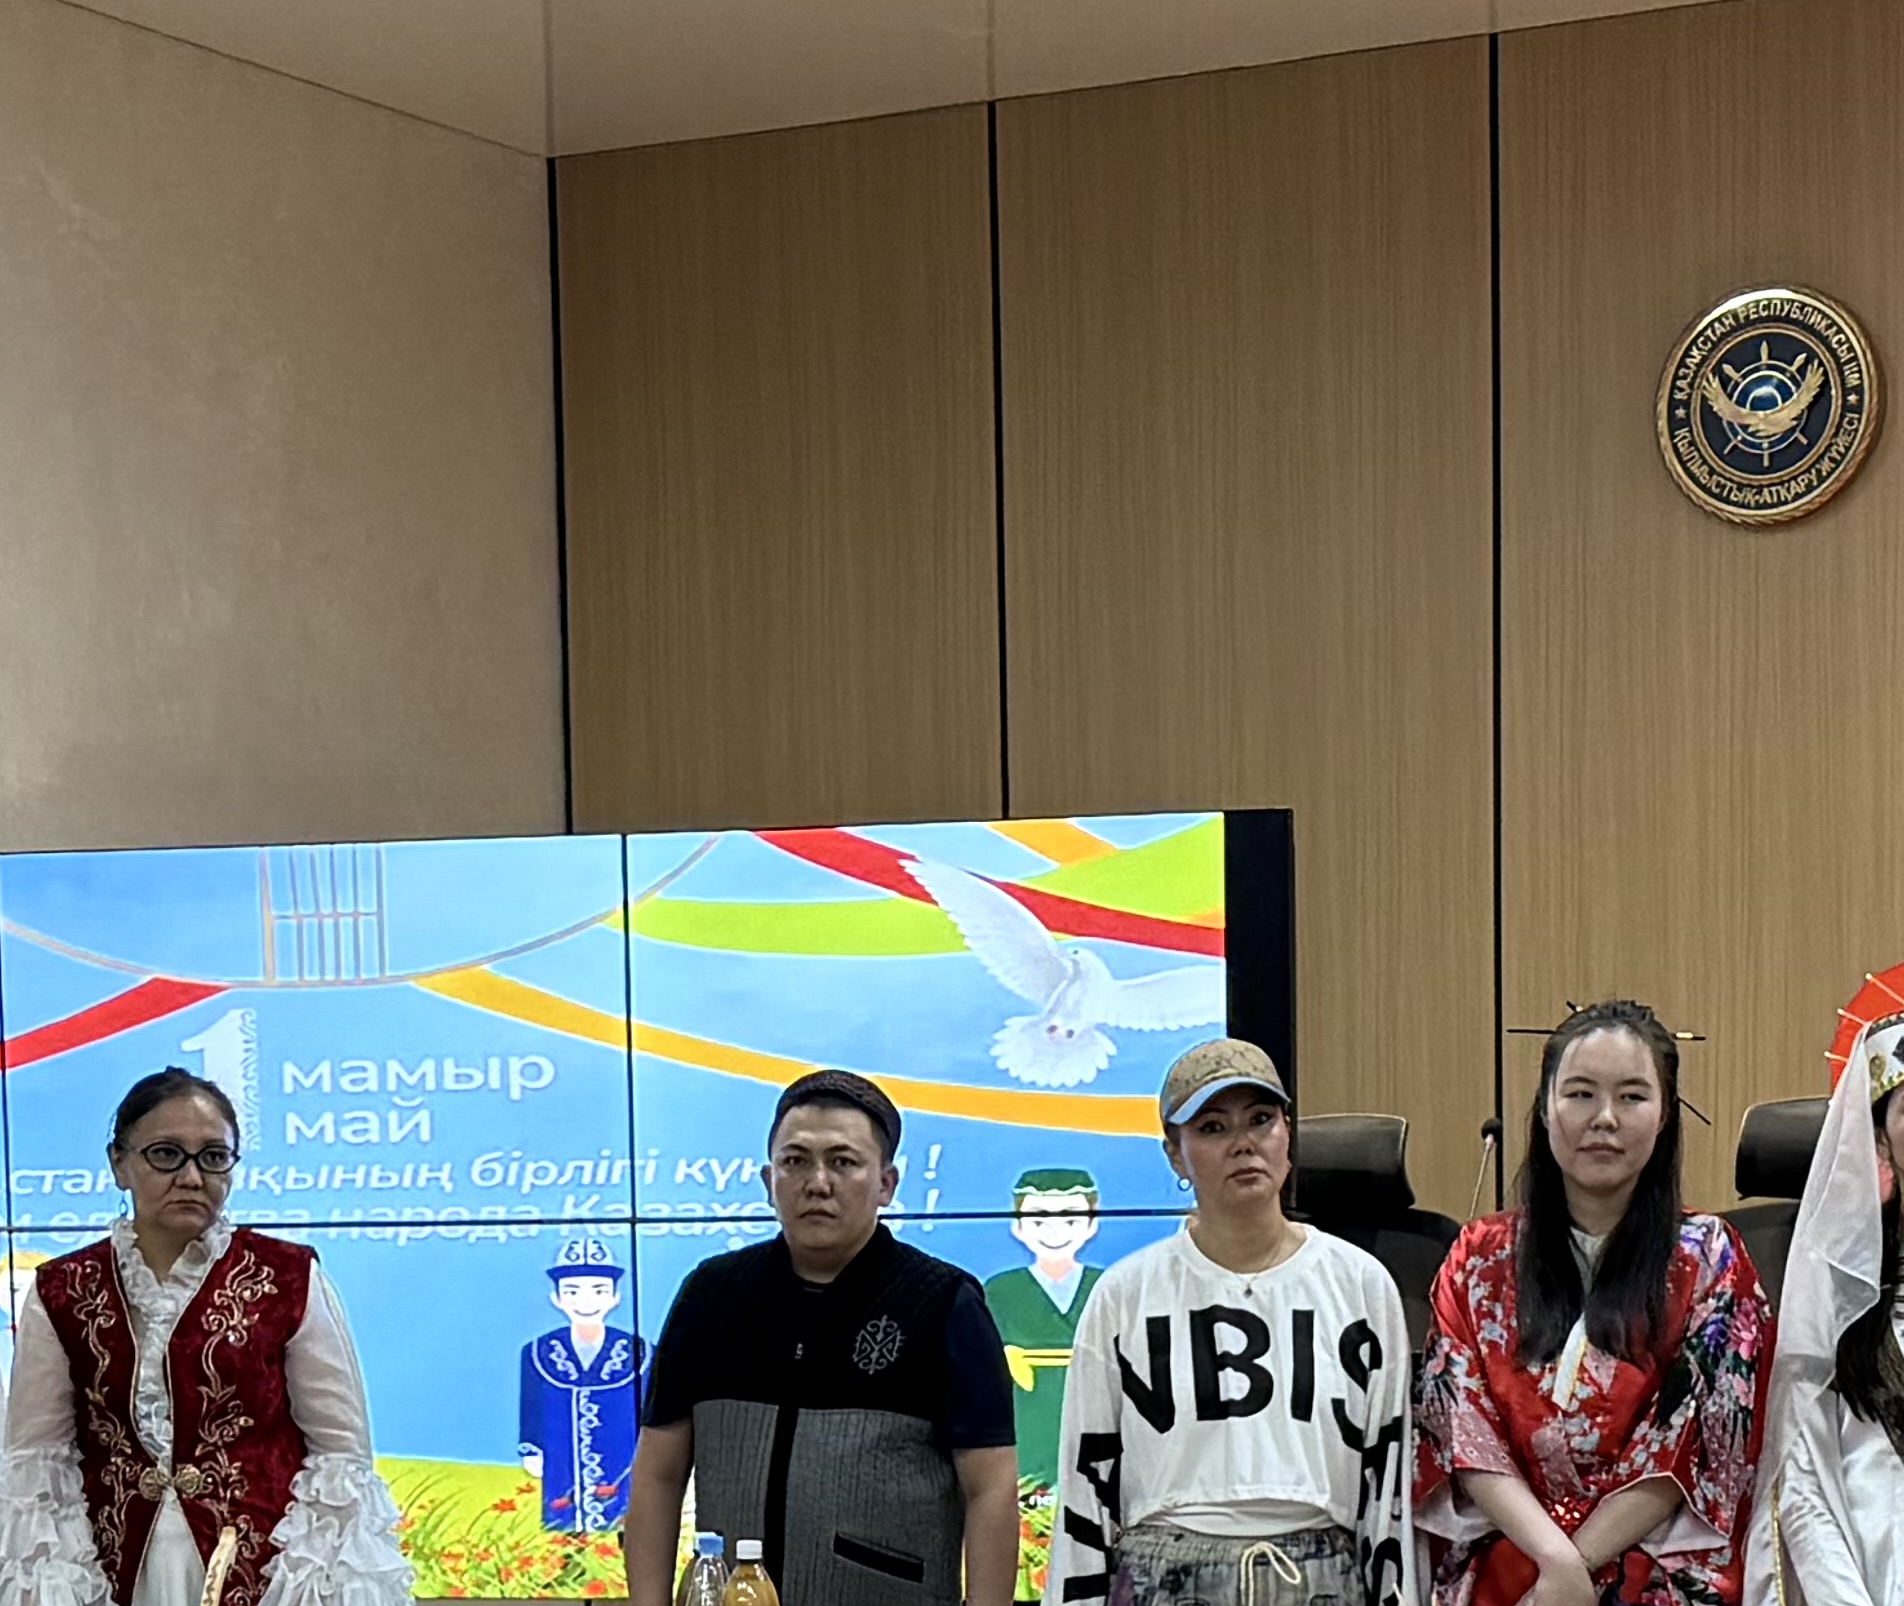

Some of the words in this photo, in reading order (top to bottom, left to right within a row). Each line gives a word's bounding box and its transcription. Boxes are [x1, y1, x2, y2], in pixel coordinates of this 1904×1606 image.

[1673, 314, 1736, 400] ҚАЗАҚСТАН
[1738, 300, 1855, 363] РЕСПУБЛИКАСЫ
[283, 1054, 555, 1099] мамыр
[284, 1094, 432, 1145] май
[232, 1163, 453, 1193] қының
[470, 1149, 660, 1195] бірлігі
[327, 1204, 542, 1246] народа
